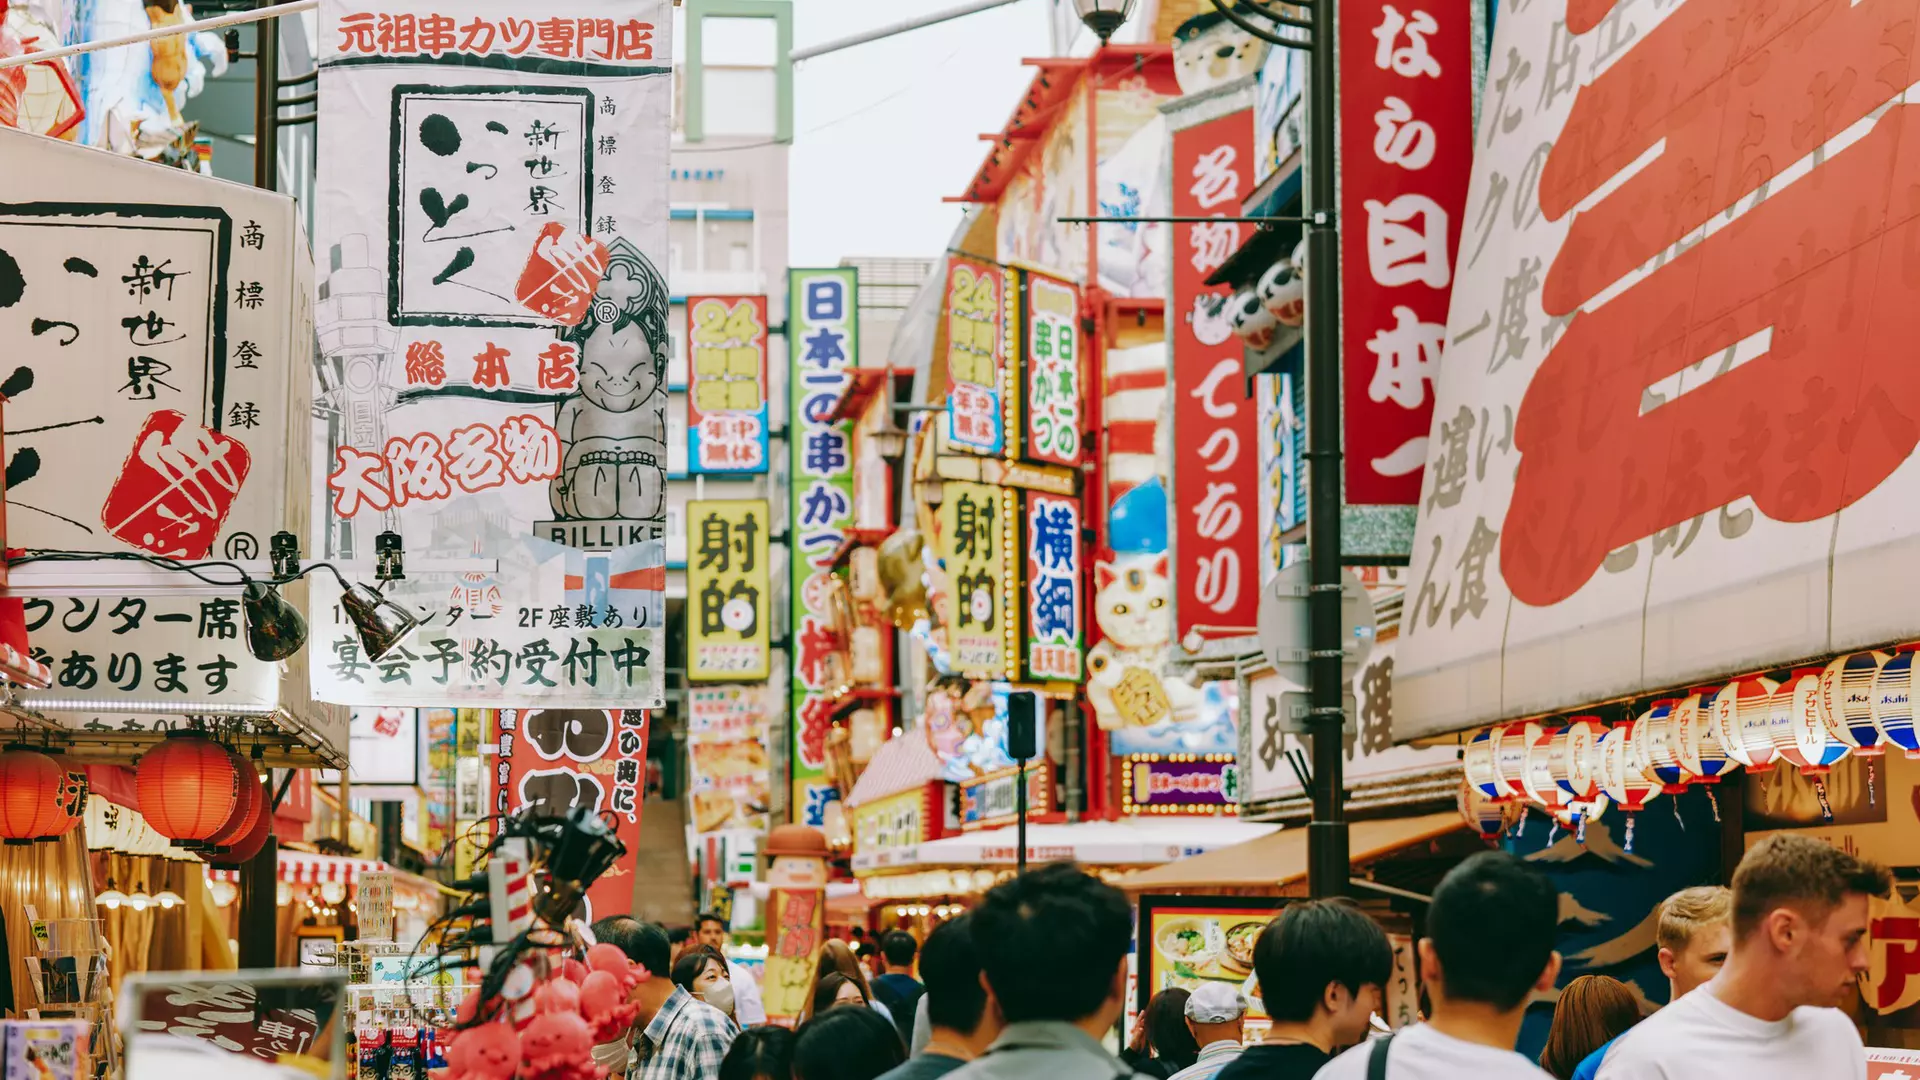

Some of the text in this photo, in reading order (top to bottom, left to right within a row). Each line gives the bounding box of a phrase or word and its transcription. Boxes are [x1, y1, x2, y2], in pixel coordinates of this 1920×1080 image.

[337, 12, 656, 61] 元祖串カツ専門店
[523, 119, 570, 216] 新世界
[595, 96, 618, 235] 商標登録
[117, 255, 192, 400] 新世界
[228, 220, 266, 430] 商標登録
[405, 340, 578, 390] 総本店
[327, 413, 563, 520] 大阪名物
[1035, 503, 1074, 641] 横綱
[518, 605, 649, 629] 2F座敷あり
[327, 635, 650, 688] 宴会予約受付中
[1806, 689, 1818, 745] アサヒビール
[1822, 670, 1839, 729] アサヒビール
[1881, 693, 1909, 704] Asahi
